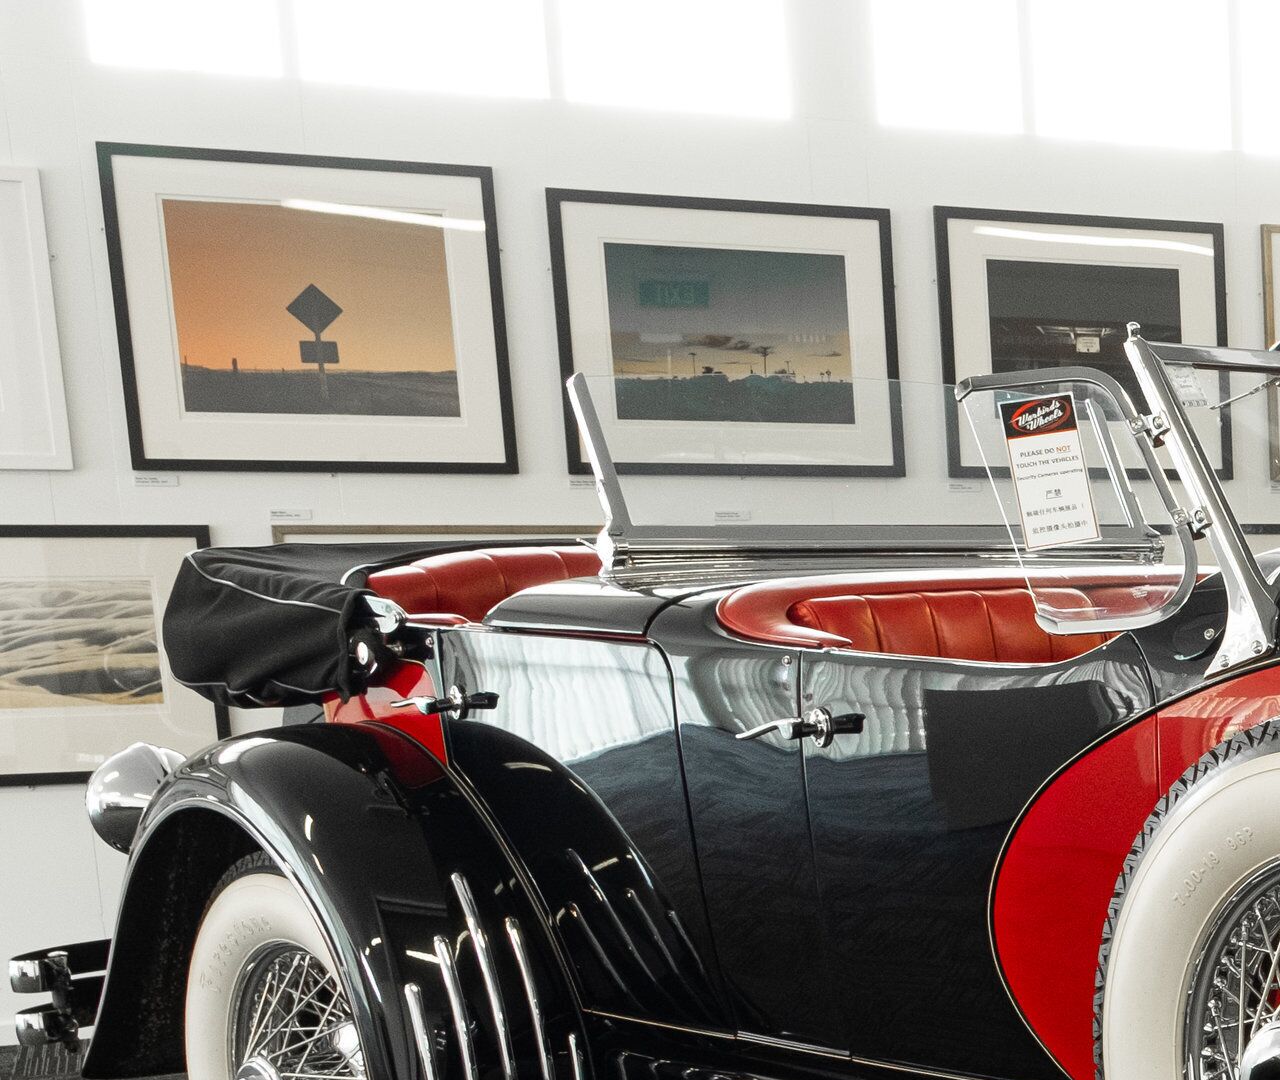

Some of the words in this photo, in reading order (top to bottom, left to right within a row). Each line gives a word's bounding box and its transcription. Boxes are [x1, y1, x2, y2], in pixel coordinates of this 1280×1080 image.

[1016, 400, 1061, 426] Warbirds
[1025, 409, 1063, 431] Wheels
[1020, 449, 1043, 458] PLEASE
[1051, 455, 1079, 464] VEHICLES
